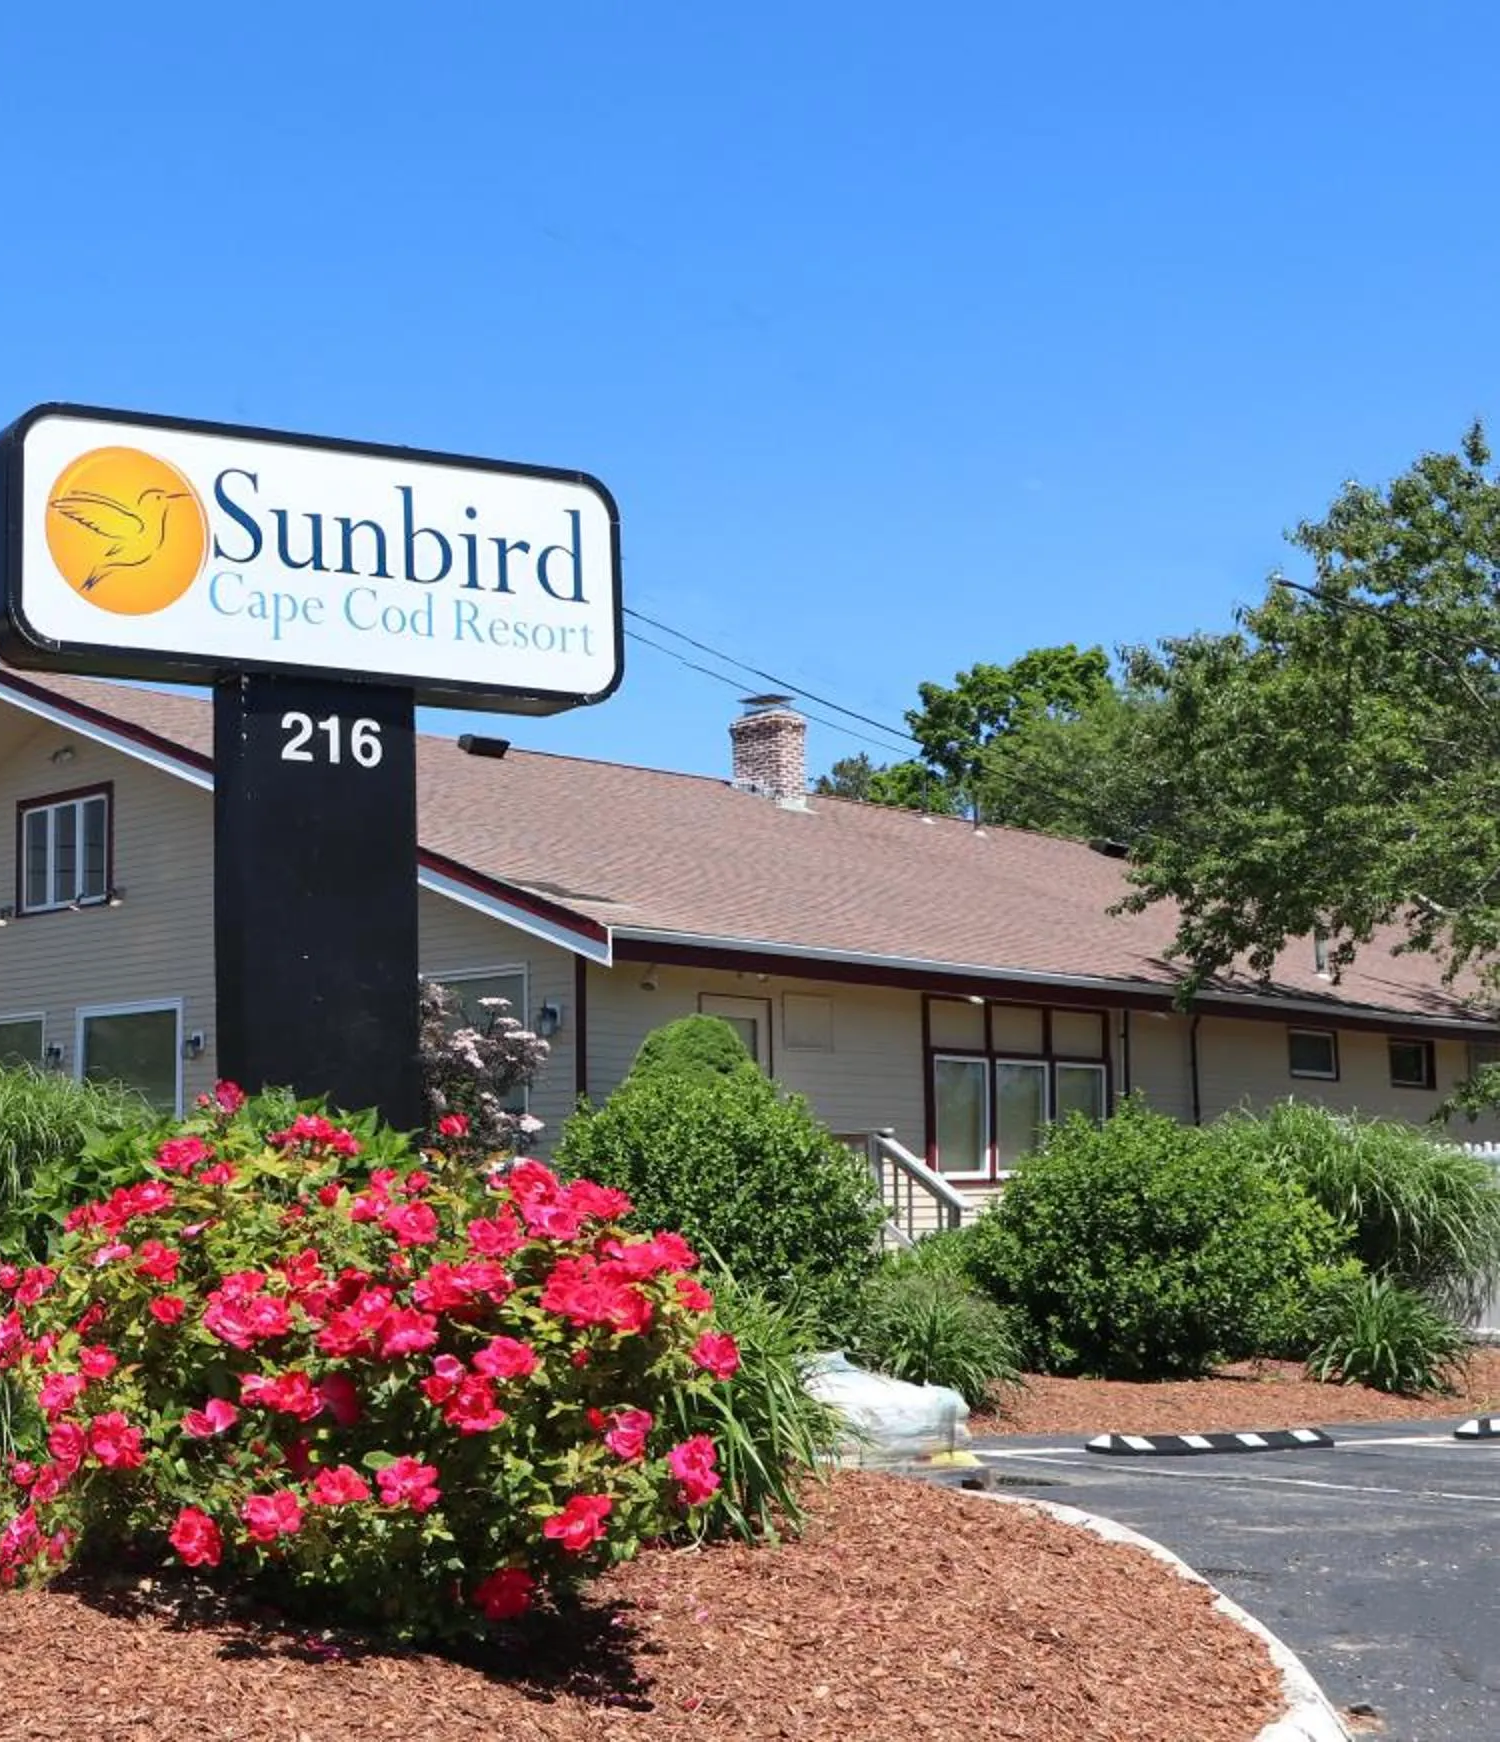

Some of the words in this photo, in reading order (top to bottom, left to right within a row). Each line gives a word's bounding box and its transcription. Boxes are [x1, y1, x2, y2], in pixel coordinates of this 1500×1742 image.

[213, 468, 591, 605] Sunbird
[208, 570, 325, 641] Cape
[342, 587, 436, 640] Cod
[451, 598, 596, 657] Resort
[281, 711, 383, 768] 216
